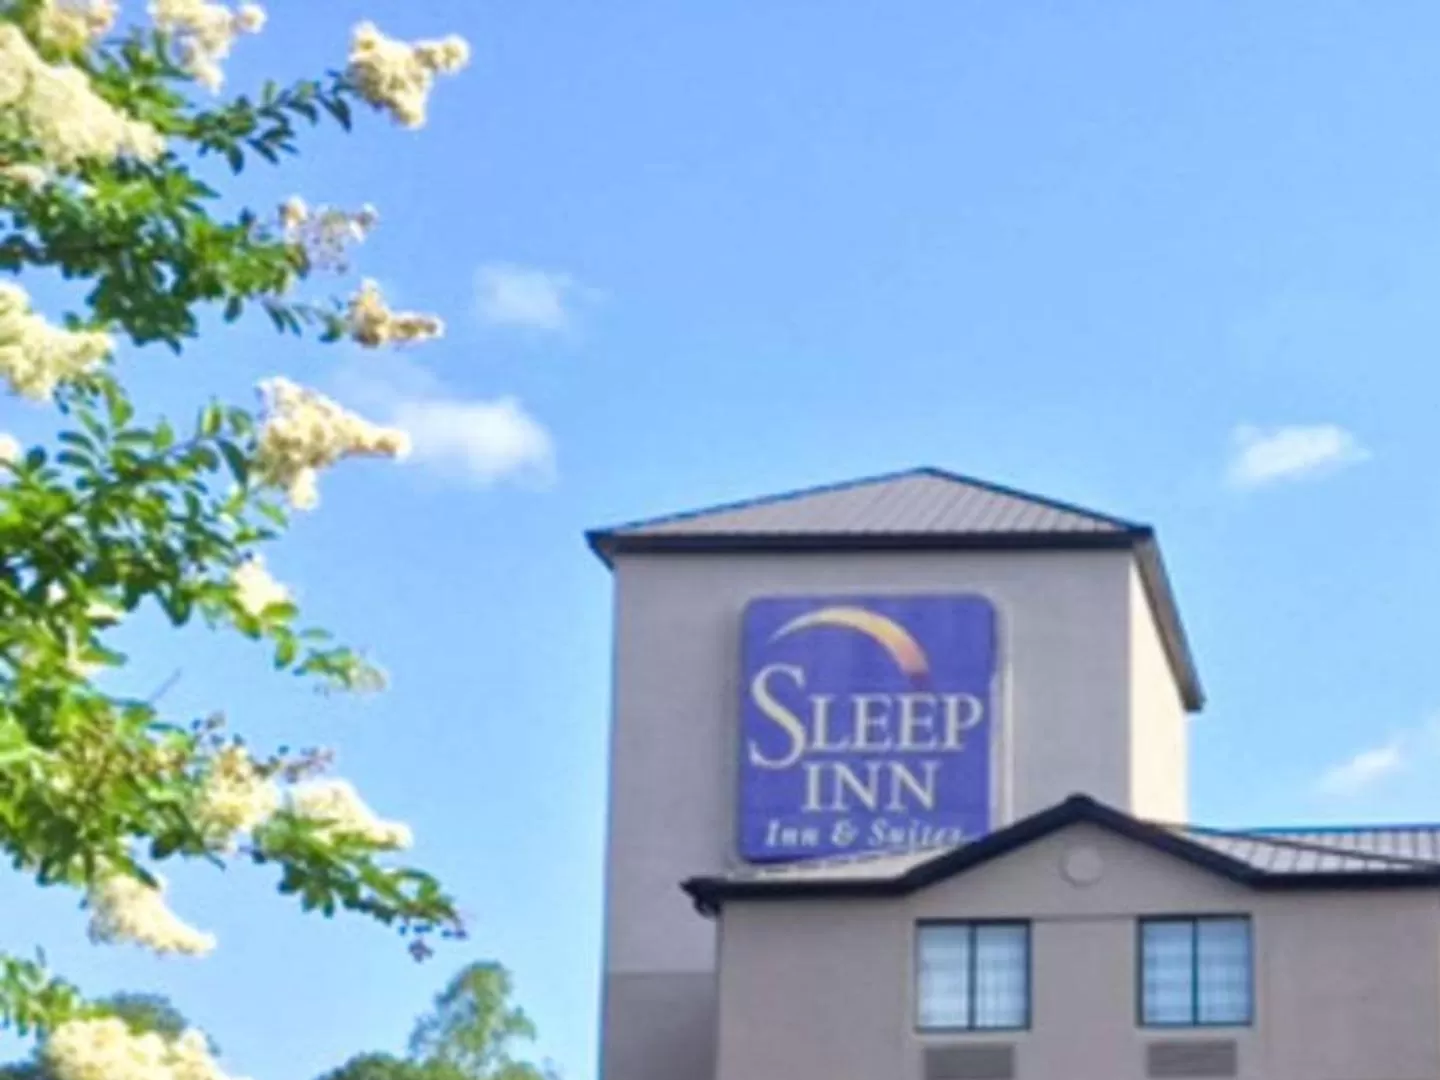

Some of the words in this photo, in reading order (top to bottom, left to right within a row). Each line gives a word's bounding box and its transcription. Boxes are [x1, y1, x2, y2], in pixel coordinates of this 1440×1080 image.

[748, 663, 984, 769] SLEEP
[802, 758, 942, 813] INN
[765, 817, 820, 847] Inn
[830, 818, 857, 847] &
